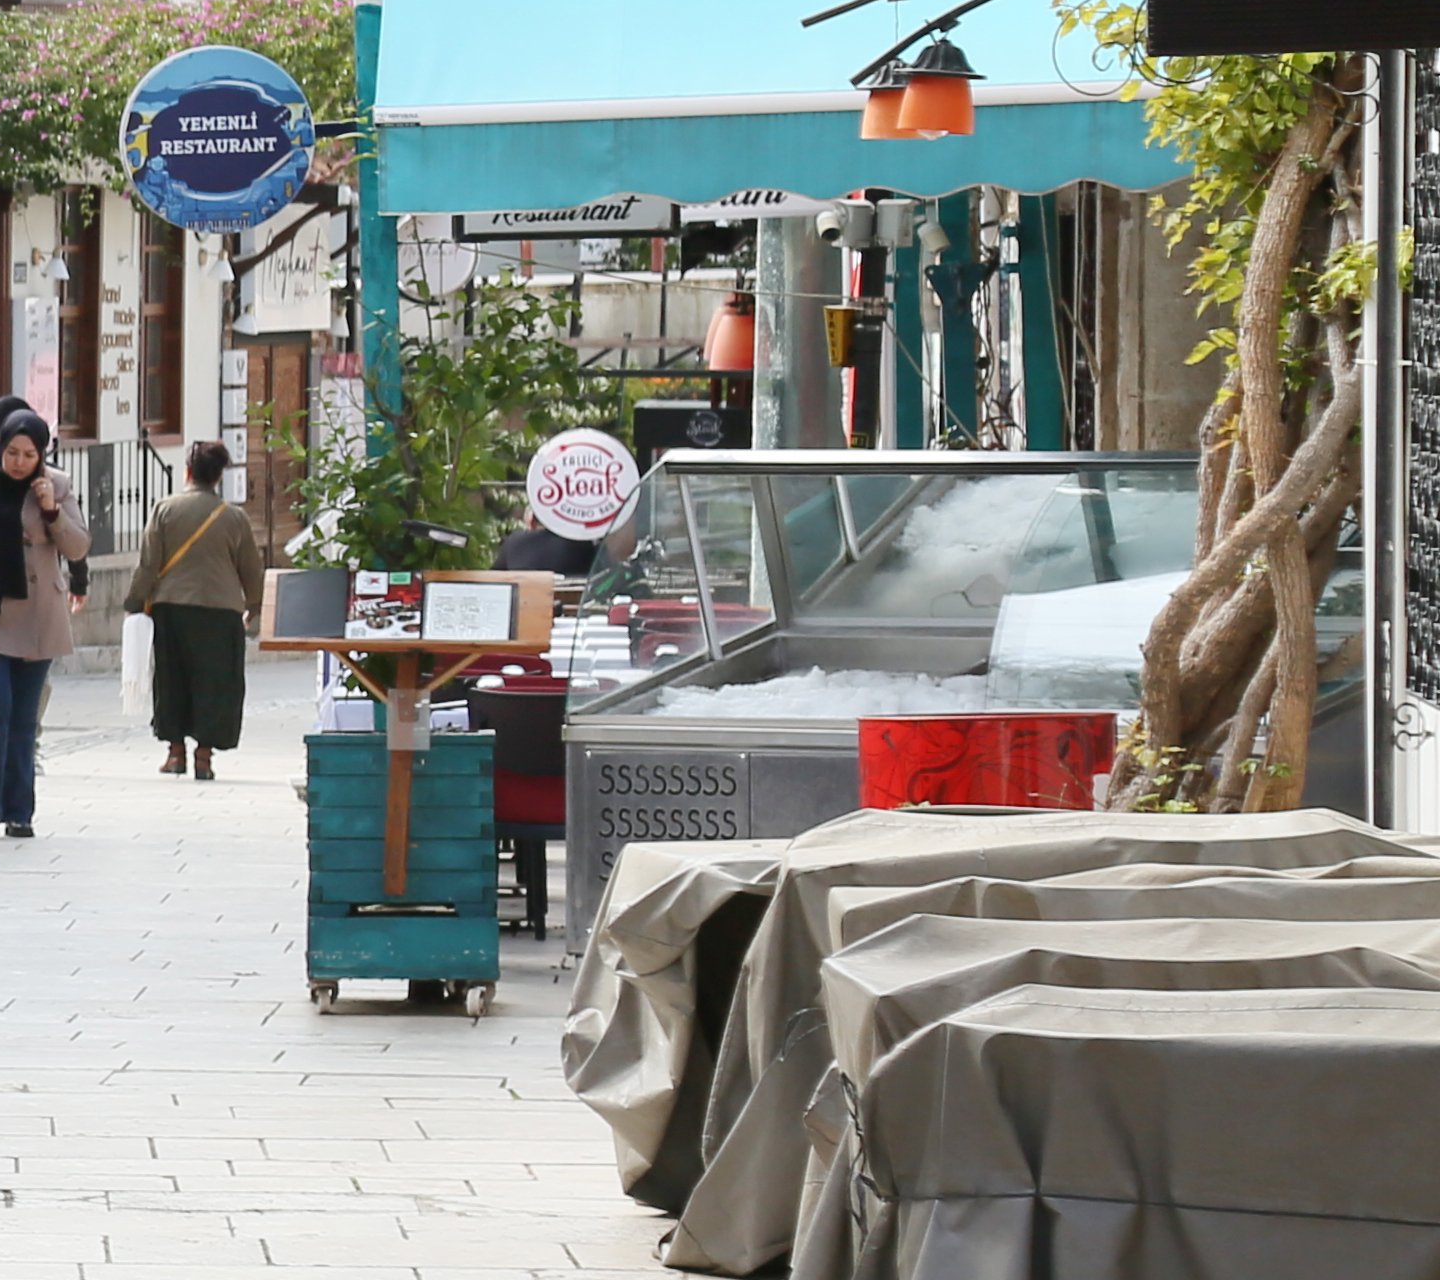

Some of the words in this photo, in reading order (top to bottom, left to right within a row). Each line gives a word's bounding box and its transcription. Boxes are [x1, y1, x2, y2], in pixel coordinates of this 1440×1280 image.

[178, 110, 258, 132] YEMENLİ
[160, 136, 277, 156] RESTAURANT
[537, 461, 626, 507] Steak
[560, 502, 595, 518] GASTRO
